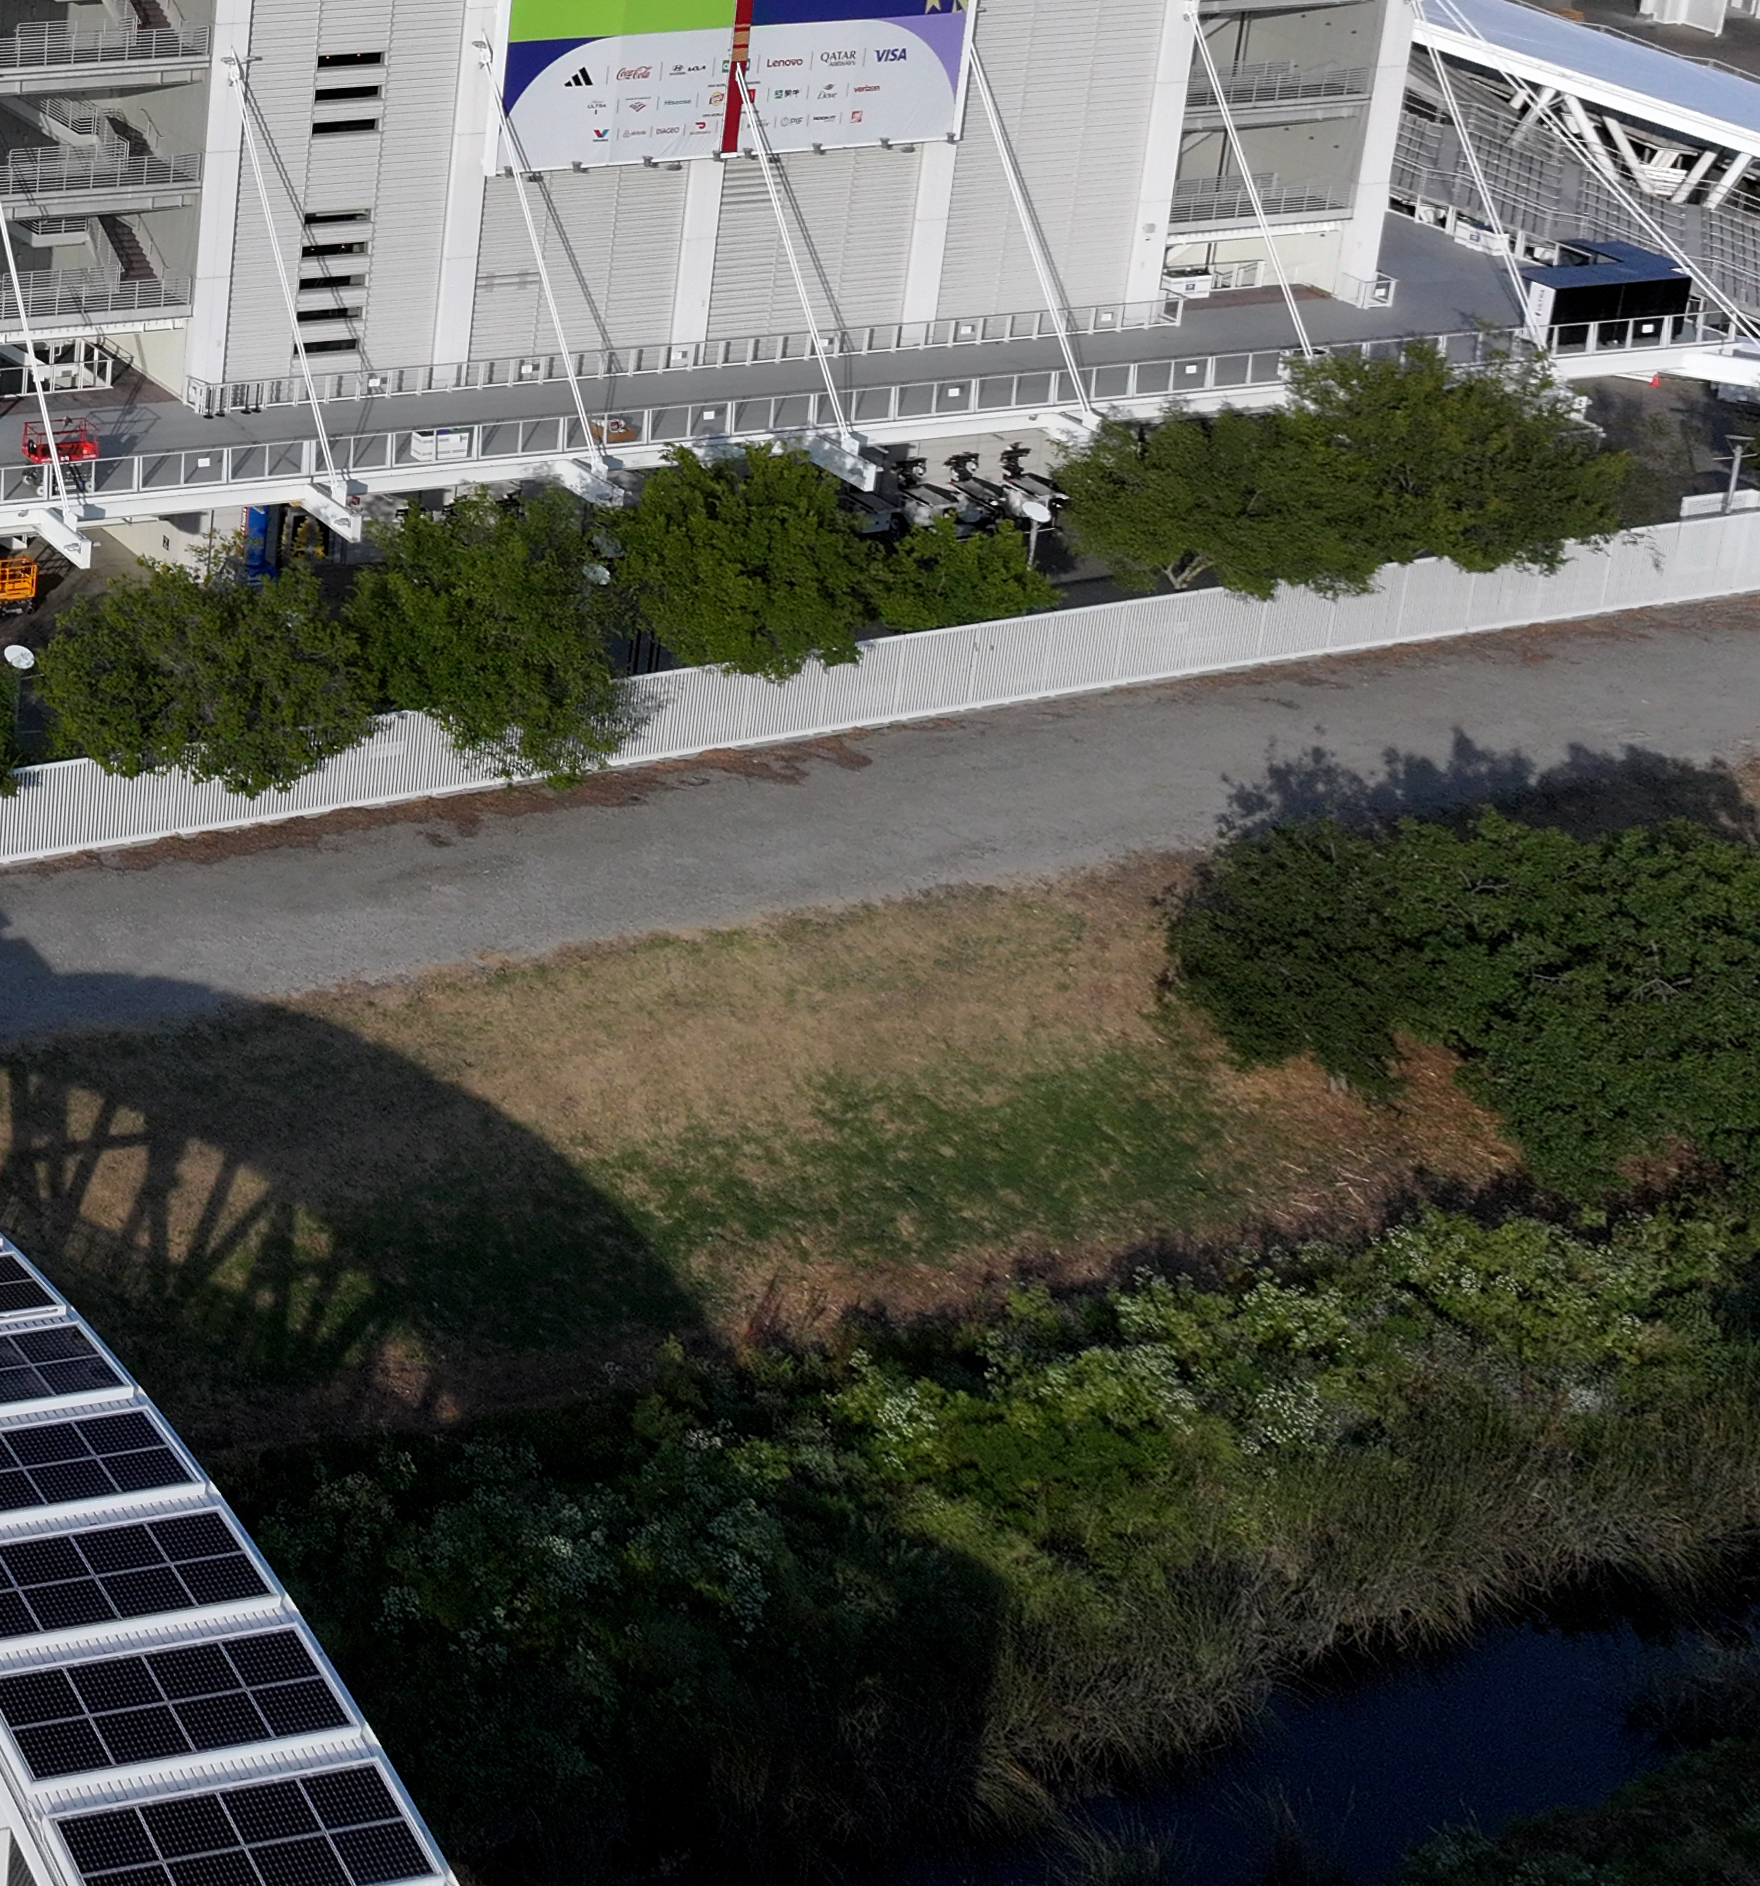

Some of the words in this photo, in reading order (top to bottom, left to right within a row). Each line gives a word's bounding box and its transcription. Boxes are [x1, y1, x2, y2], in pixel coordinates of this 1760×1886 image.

[820, 50, 857, 63] QATAR
[874, 47, 908, 63] VISA
[766, 58, 804, 68] Lenovo
[656, 126, 680, 135] DIAGEO
